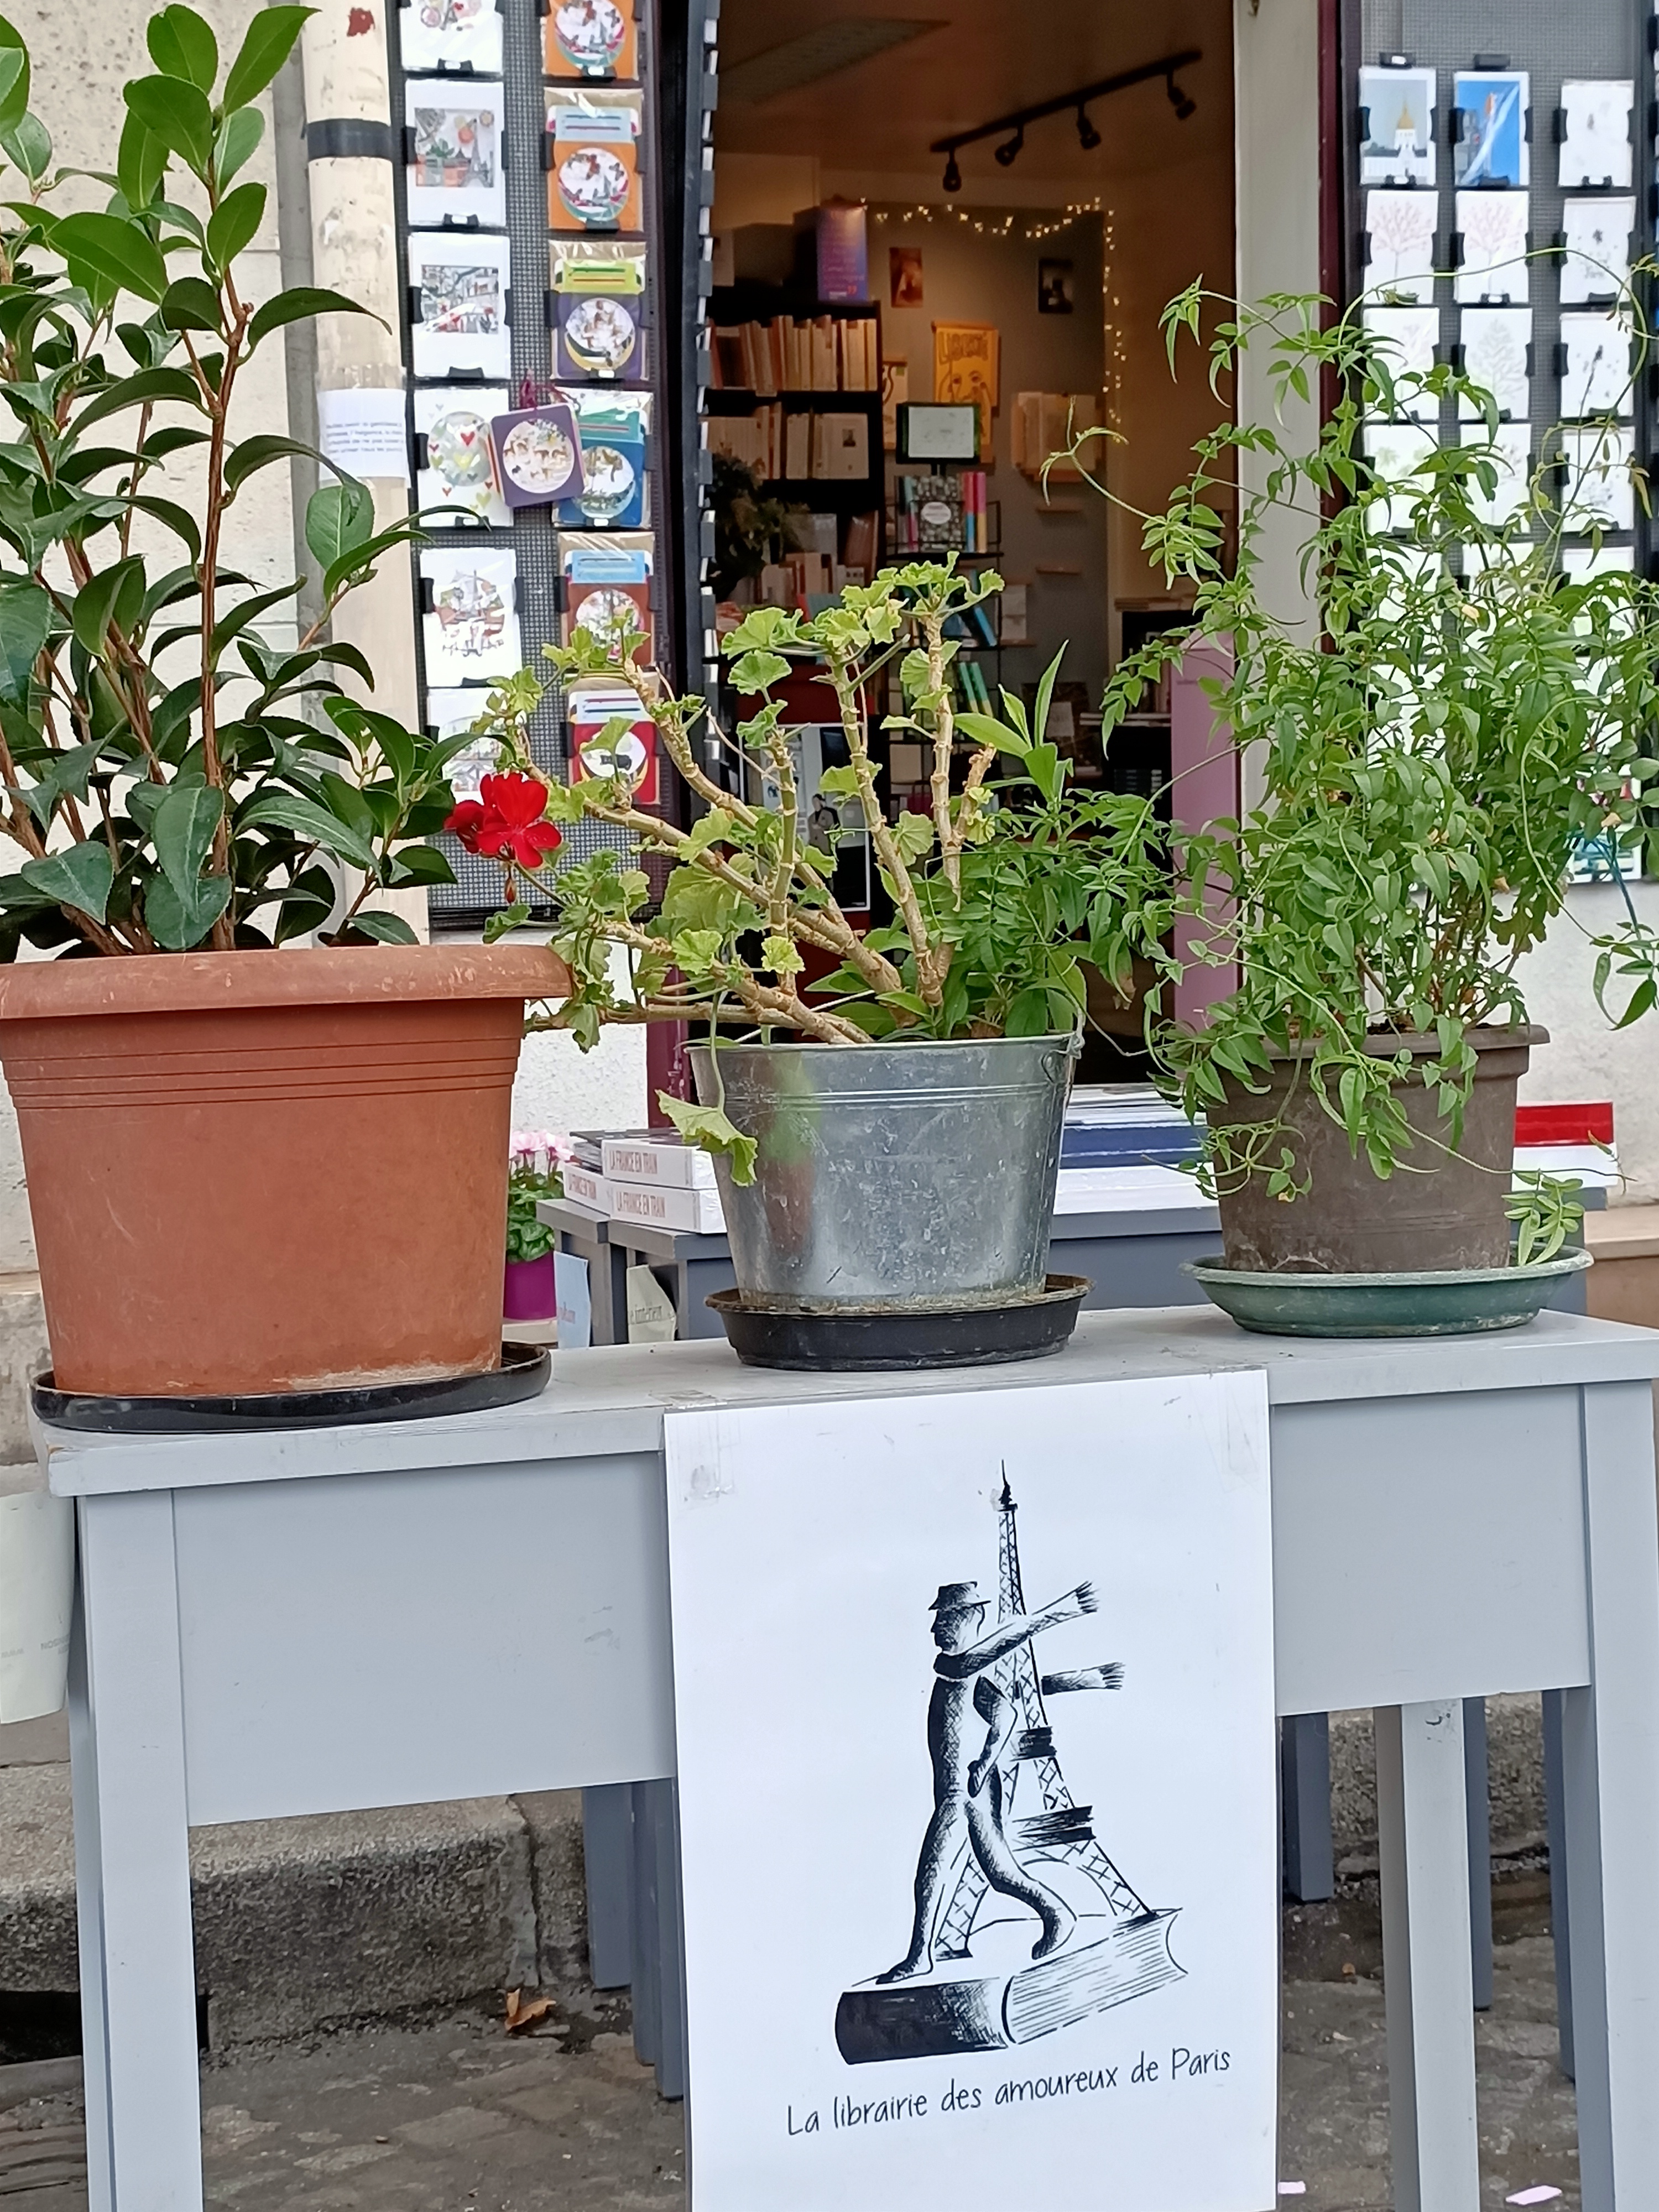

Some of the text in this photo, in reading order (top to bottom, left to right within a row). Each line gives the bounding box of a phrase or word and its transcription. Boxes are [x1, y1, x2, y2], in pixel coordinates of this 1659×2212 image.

[787, 2048, 1231, 2136] La librairie des amoureux de Paris
